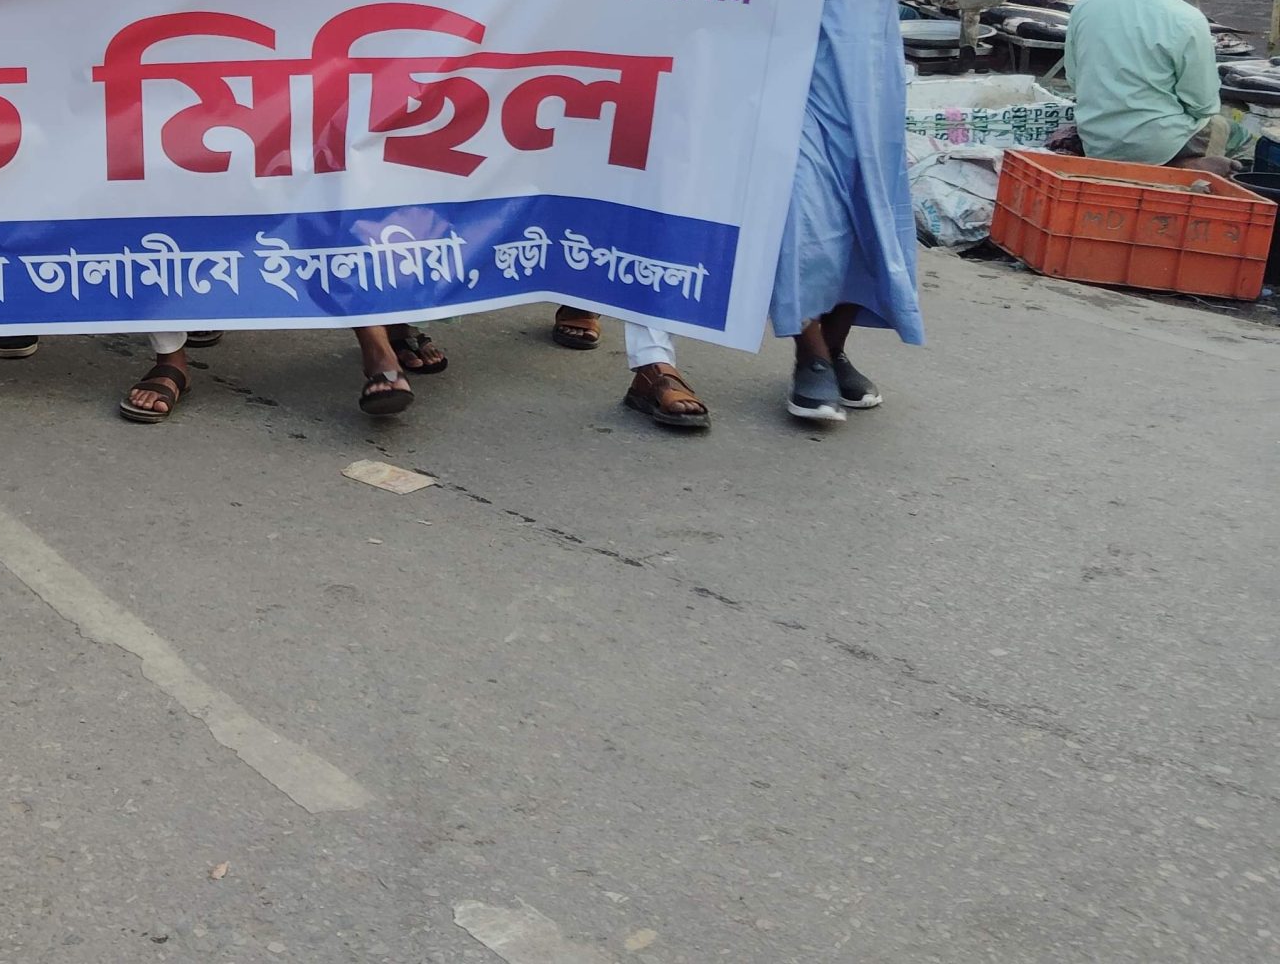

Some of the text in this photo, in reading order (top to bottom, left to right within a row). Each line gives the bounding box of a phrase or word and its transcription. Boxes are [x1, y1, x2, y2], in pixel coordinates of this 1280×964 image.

[92, 2, 674, 181] মিছিল
[18, 233, 244, 301] তালামীযে
[254, 224, 480, 300] ইসলামিয়া,
[492, 227, 553, 280] জুড়ী
[560, 228, 708, 301] উপজেলা
